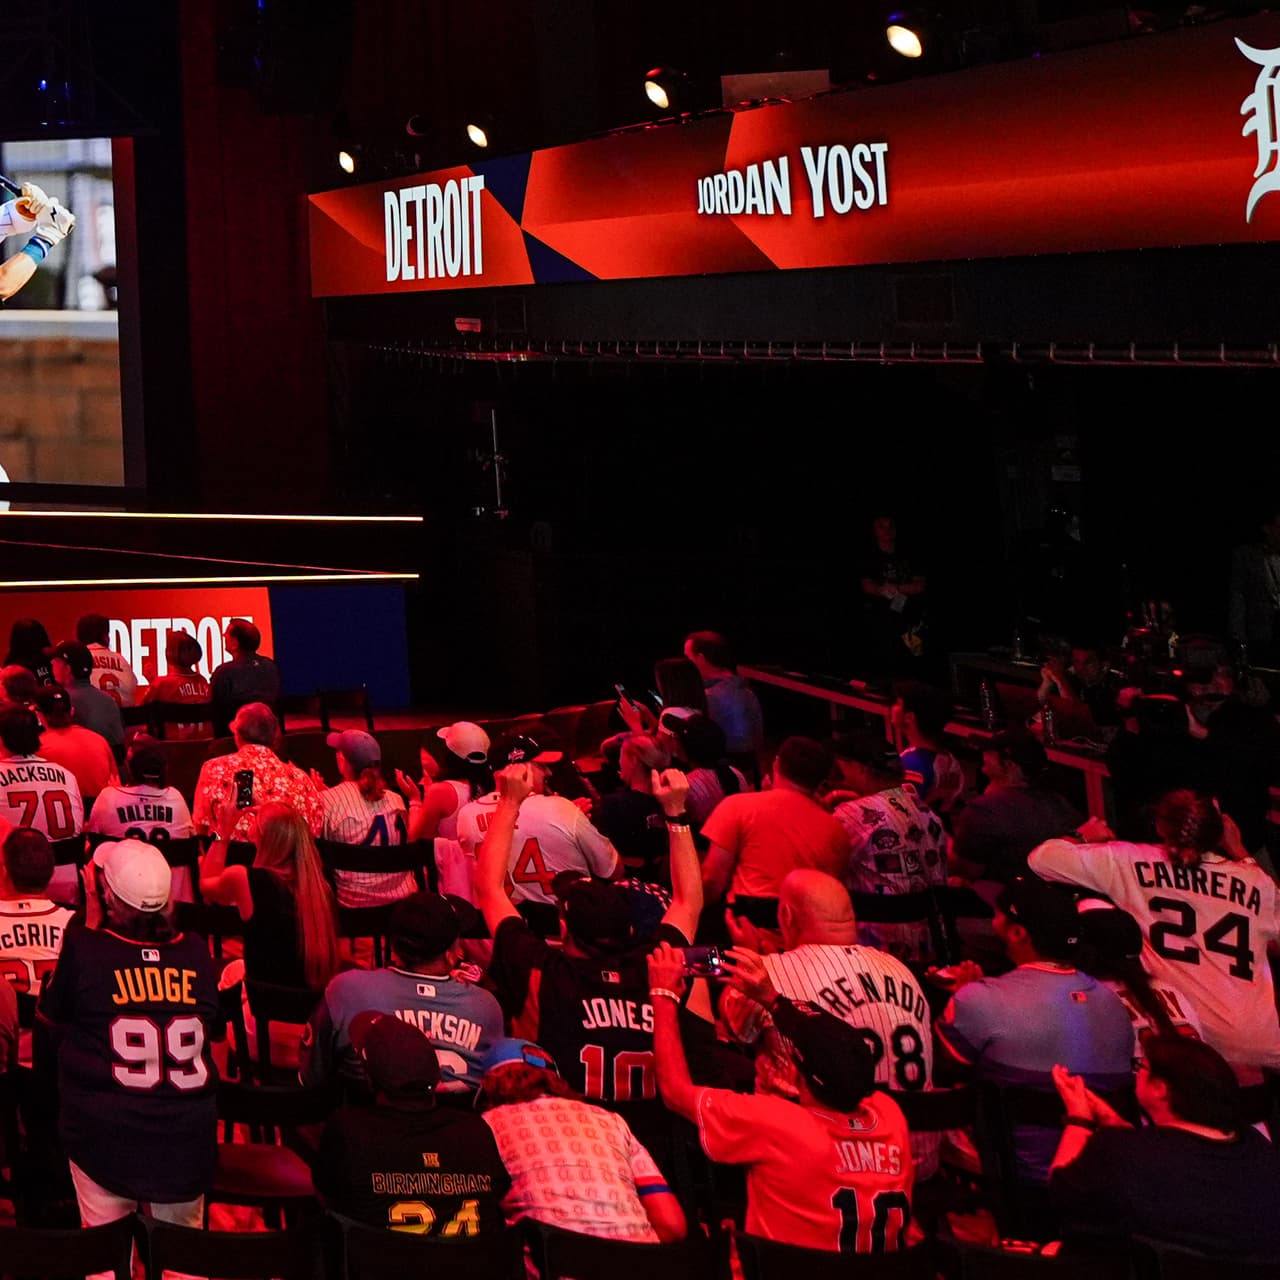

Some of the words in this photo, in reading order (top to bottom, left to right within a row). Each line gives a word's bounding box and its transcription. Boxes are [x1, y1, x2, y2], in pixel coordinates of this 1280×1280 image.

[697, 156, 792, 215] JORDAN
[801, 142, 888, 218] YOST
[384, 175, 485, 282] DETROIT
[0, 766, 66, 787] JACKSON
[7, 790, 75, 839] 70
[116, 805, 173, 824] RALEIGH
[1134, 861, 1260, 916] CABRERA
[1149, 896, 1255, 982] 24
[112, 967, 197, 1005] JUDGE
[819, 972, 925, 1022] RENADO
[582, 998, 654, 1033] JONES
[109, 1014, 210, 1090] 99
[580, 1044, 656, 1102] 10
[835, 1140, 901, 1175] JONES
[372, 1173, 491, 1195] BIRMINGHAM
[831, 1186, 908, 1253] 10
